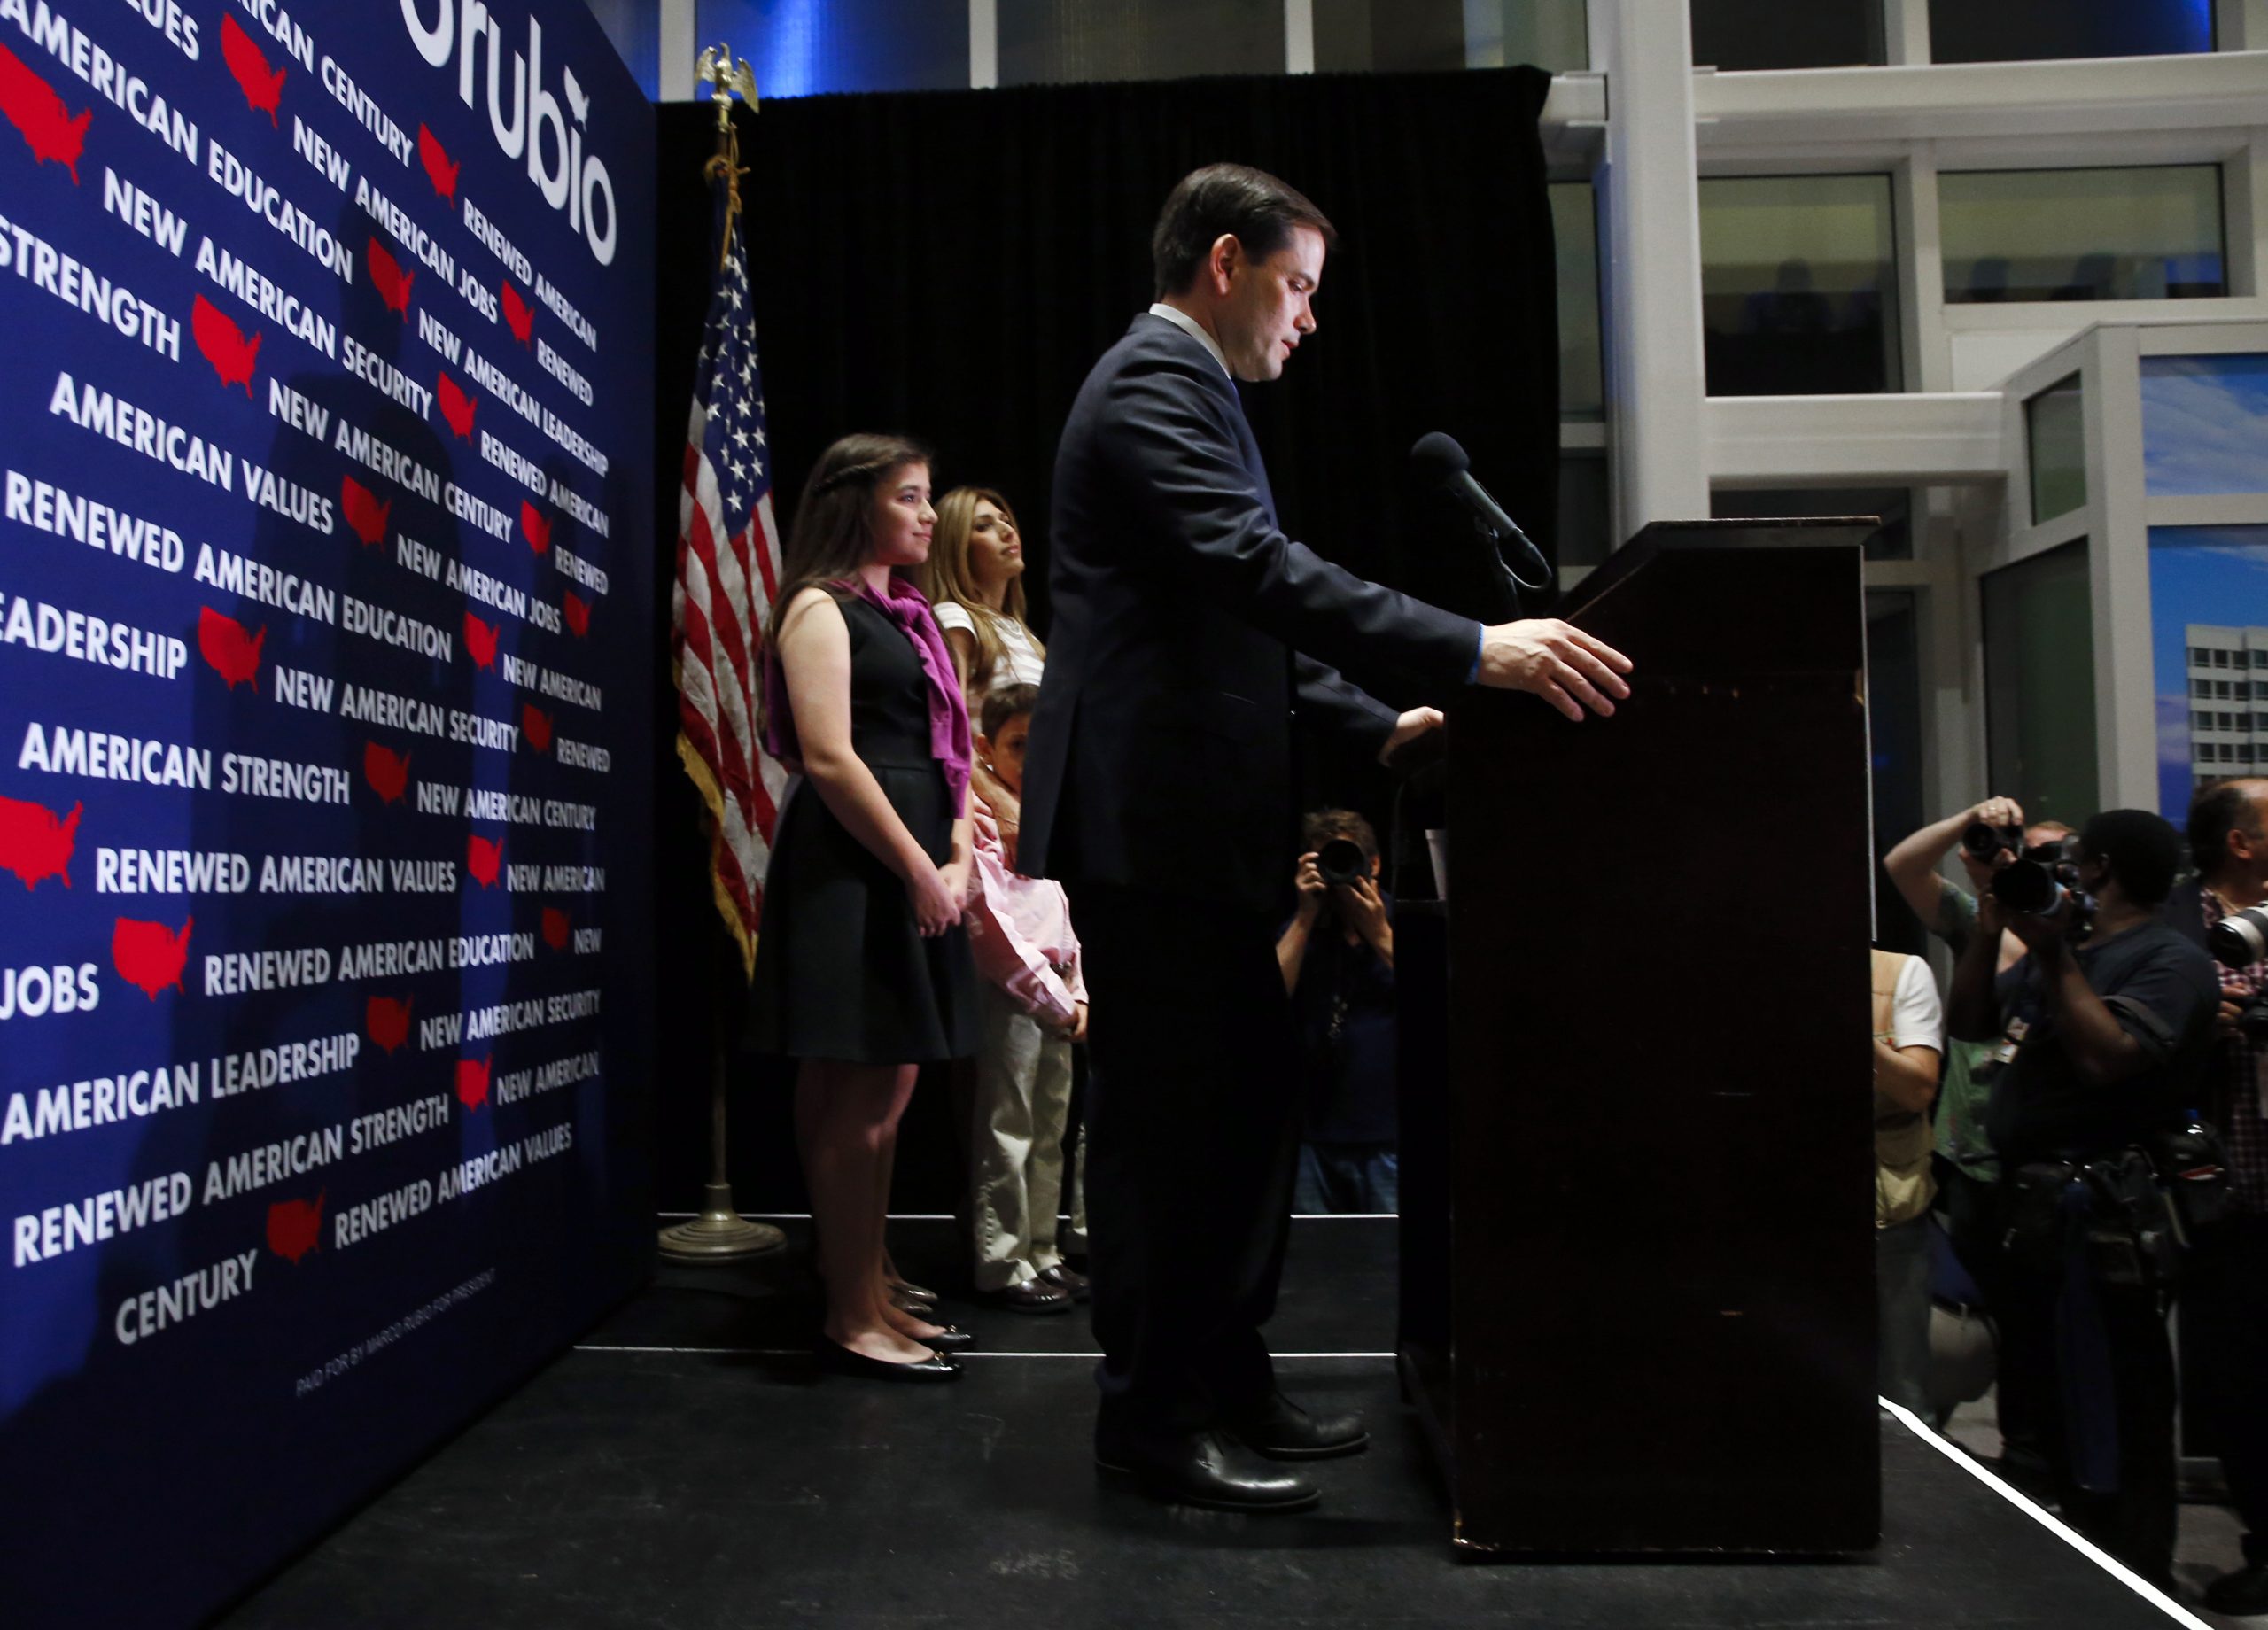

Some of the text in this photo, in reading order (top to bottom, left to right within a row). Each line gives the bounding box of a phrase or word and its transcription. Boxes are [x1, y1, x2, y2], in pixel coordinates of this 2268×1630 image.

[0, 0, 609, 477] AMERICAN EDUCATION NEW AMERICAN LEADERSHIP
[125, 0, 594, 407] UES NEW AMERICAN JOBS RENEWED
[321, 55, 414, 168] CENTURY
[463, 197, 532, 287] RENEWED
[534, 271, 597, 352] AMERICAN
[104, 166, 610, 539] NEW AMERICAN SECURITY RENEWED AMERICAN
[5, 469, 602, 711] RENEWED AMERICAN EDUCATION NEW AMERICAN
[50, 370, 562, 635] AMERICAN VALUES NEW AMERICAN JOBS
[269, 376, 329, 442] NEW
[334, 418, 439, 504] AMERICAN
[444, 481, 513, 544] CENTURY
[555, 545, 609, 595] RENEWED
[0, 592, 611, 773] ADERSHIP NEW AMERICAN SECURITY RENEWED
[18, 722, 596, 830] AMERICAN STRENGTH NEW AMERICAN CENTURY
[0, 928, 602, 1021] JOBS RENEWED AMERICAN EDUCATION NEW
[96, 847, 605, 894] RENEWED AMERICAN VALUES NEW AMERICAN
[1, 989, 601, 1145] AMERICAN LEADERSHIP NEW AMERICAN SECURITY
[14, 1051, 599, 1268] RENEWED AMERICAN STRENGTH NEW AMERICAN
[115, 1122, 572, 1346] CENTURY RENEWED AMERICAN VALUES
[296, 1369, 323, 1397] PAID
[325, 1354, 349, 1380] FOR
[351, 1346, 363, 1365] BY
[366, 1322, 403, 1355] MARCO
